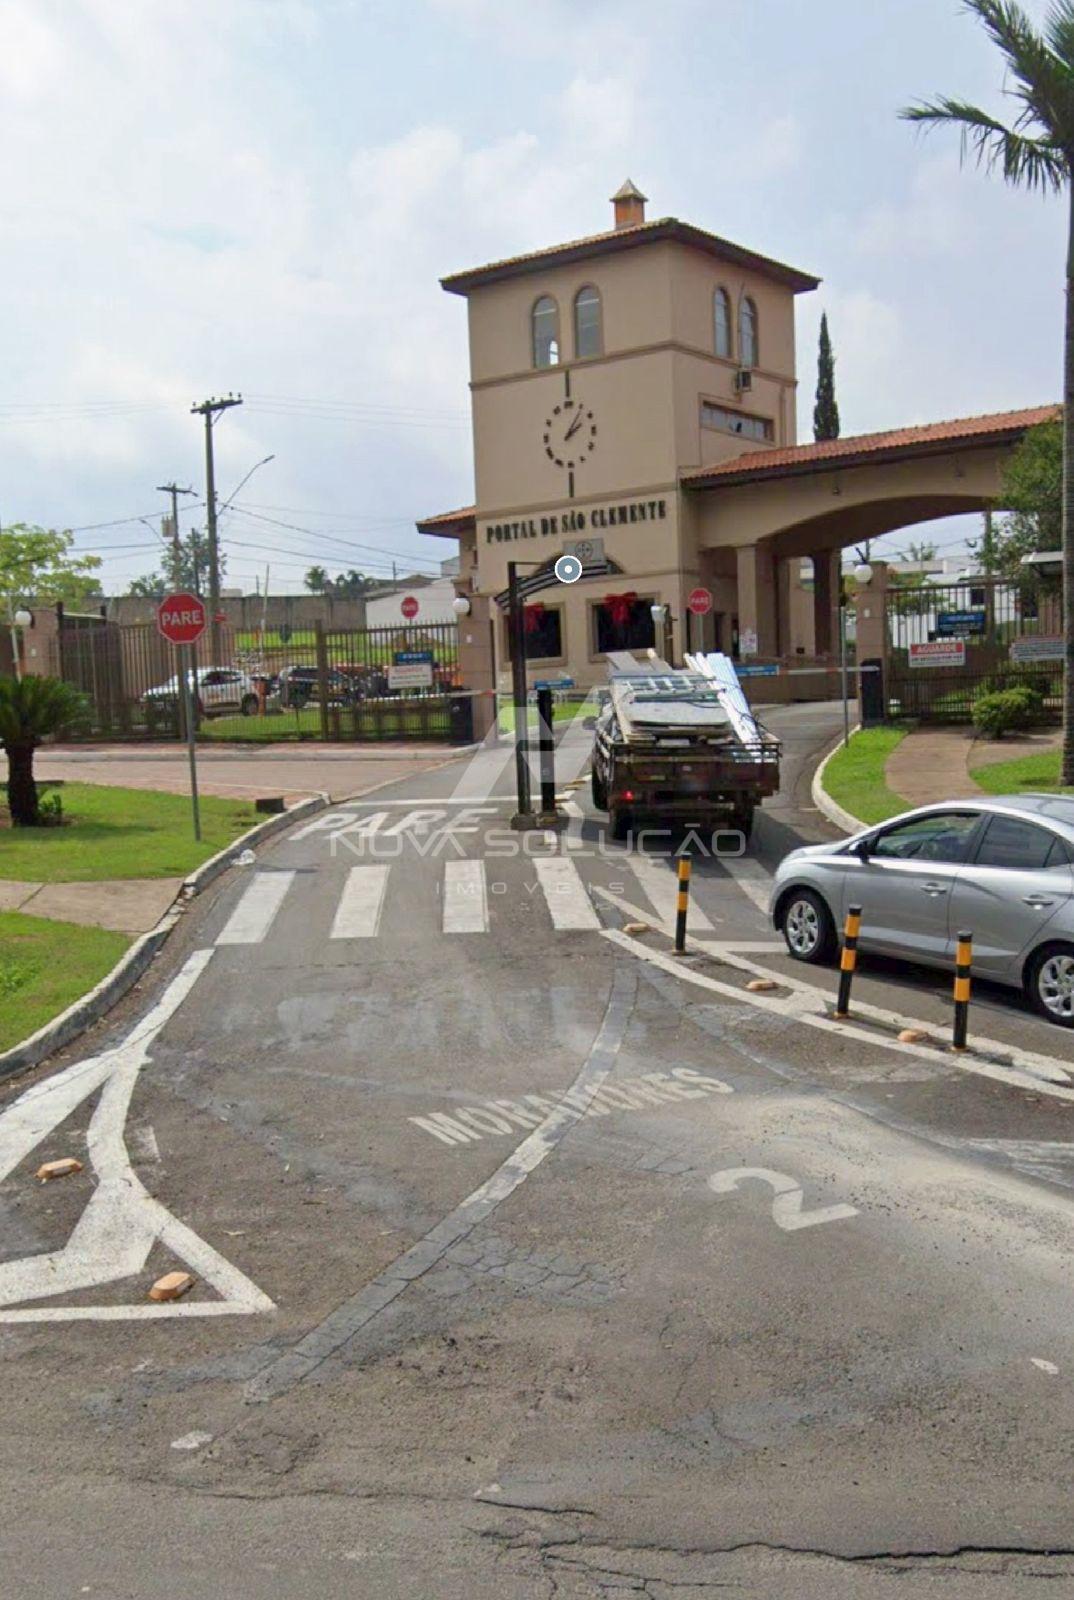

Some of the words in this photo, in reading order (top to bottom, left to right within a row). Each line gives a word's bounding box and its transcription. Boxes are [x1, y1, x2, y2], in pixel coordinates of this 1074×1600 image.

[486, 520, 537, 543] PORTAL
[541, 516, 558, 537] DE
[561, 510, 586, 533] SÃO
[591, 500, 667, 529] CLEMENTE
[161, 609, 203, 626] PARE
[288, 808, 498, 842] PARE
[706, 1166, 862, 1232] 2
